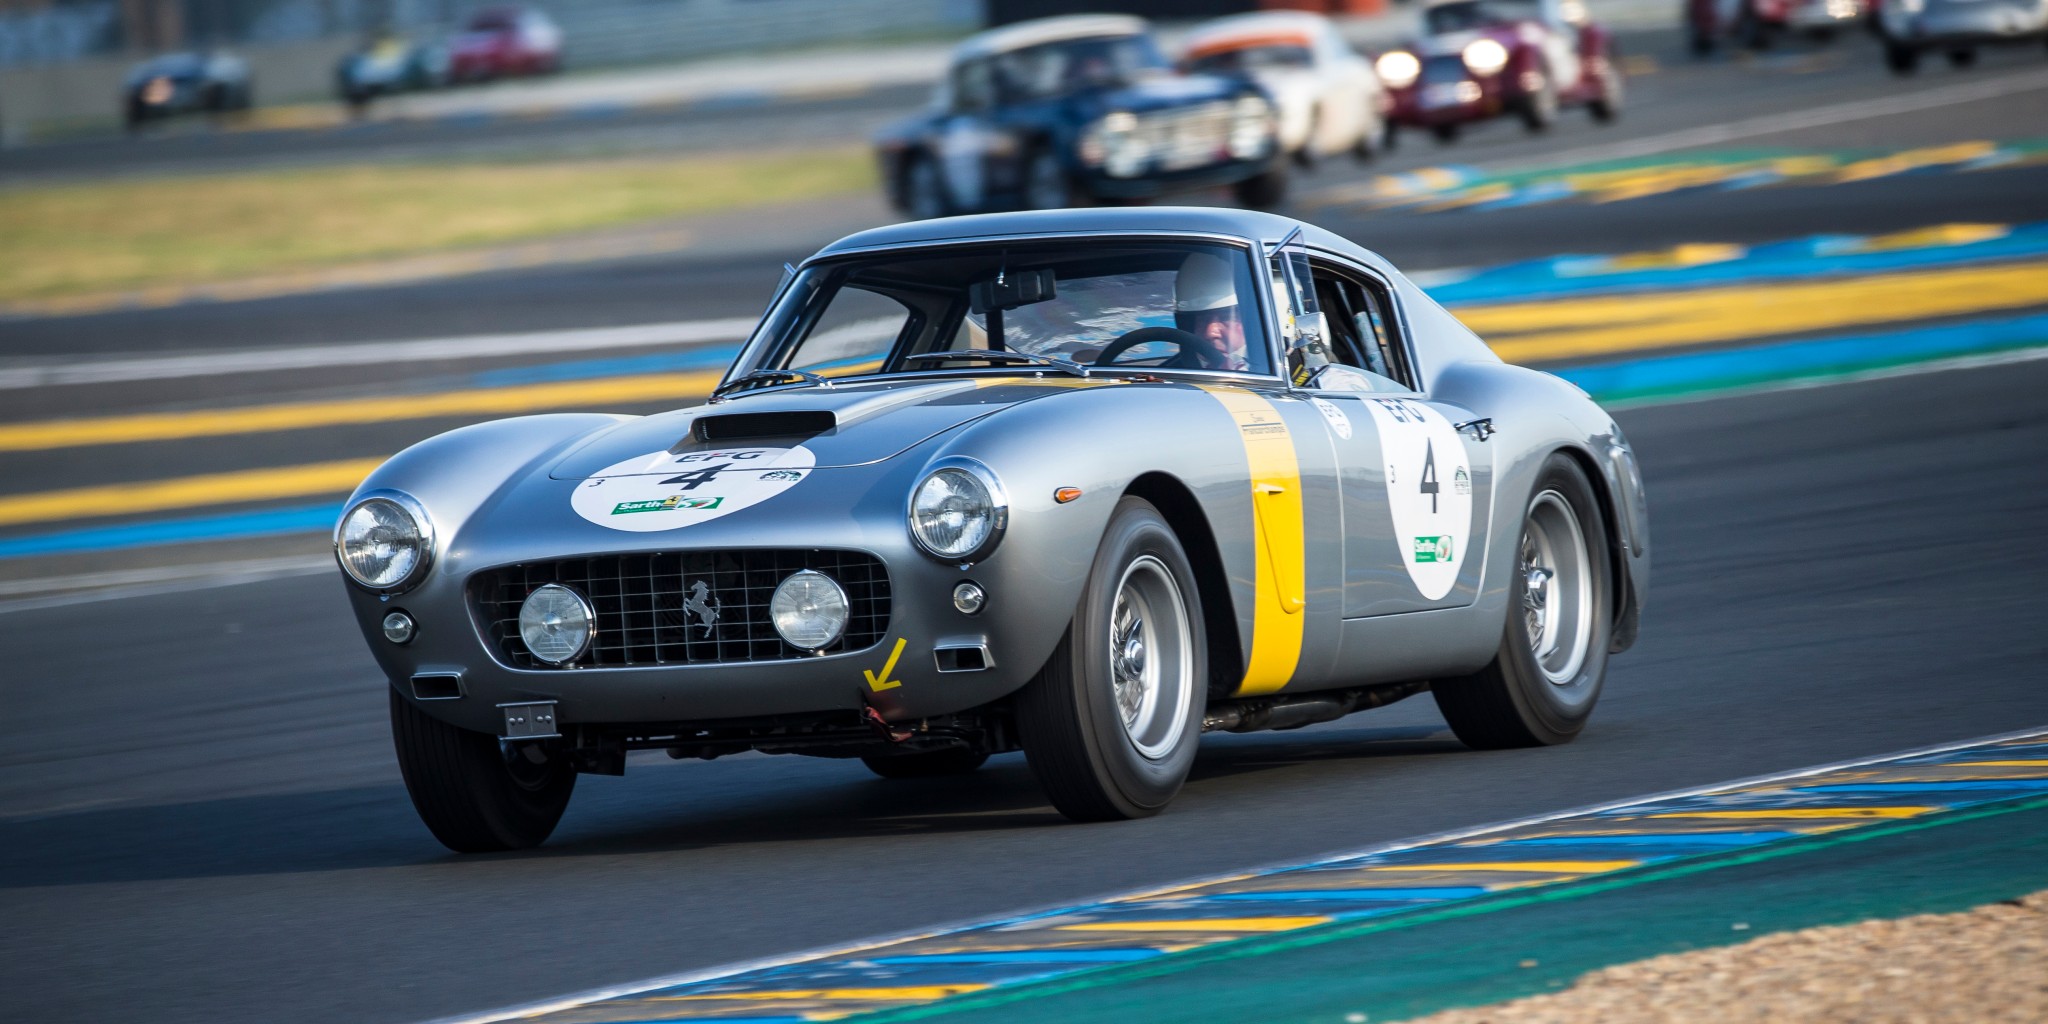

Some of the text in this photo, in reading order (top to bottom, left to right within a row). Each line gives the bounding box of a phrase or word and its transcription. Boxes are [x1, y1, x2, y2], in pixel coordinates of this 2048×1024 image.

[1372, 398, 1425, 422] EFG
[675, 450, 766, 463] EFG
[588, 479, 606, 488] 3
[657, 462, 734, 491] 4
[1420, 437, 1440, 514] 4
